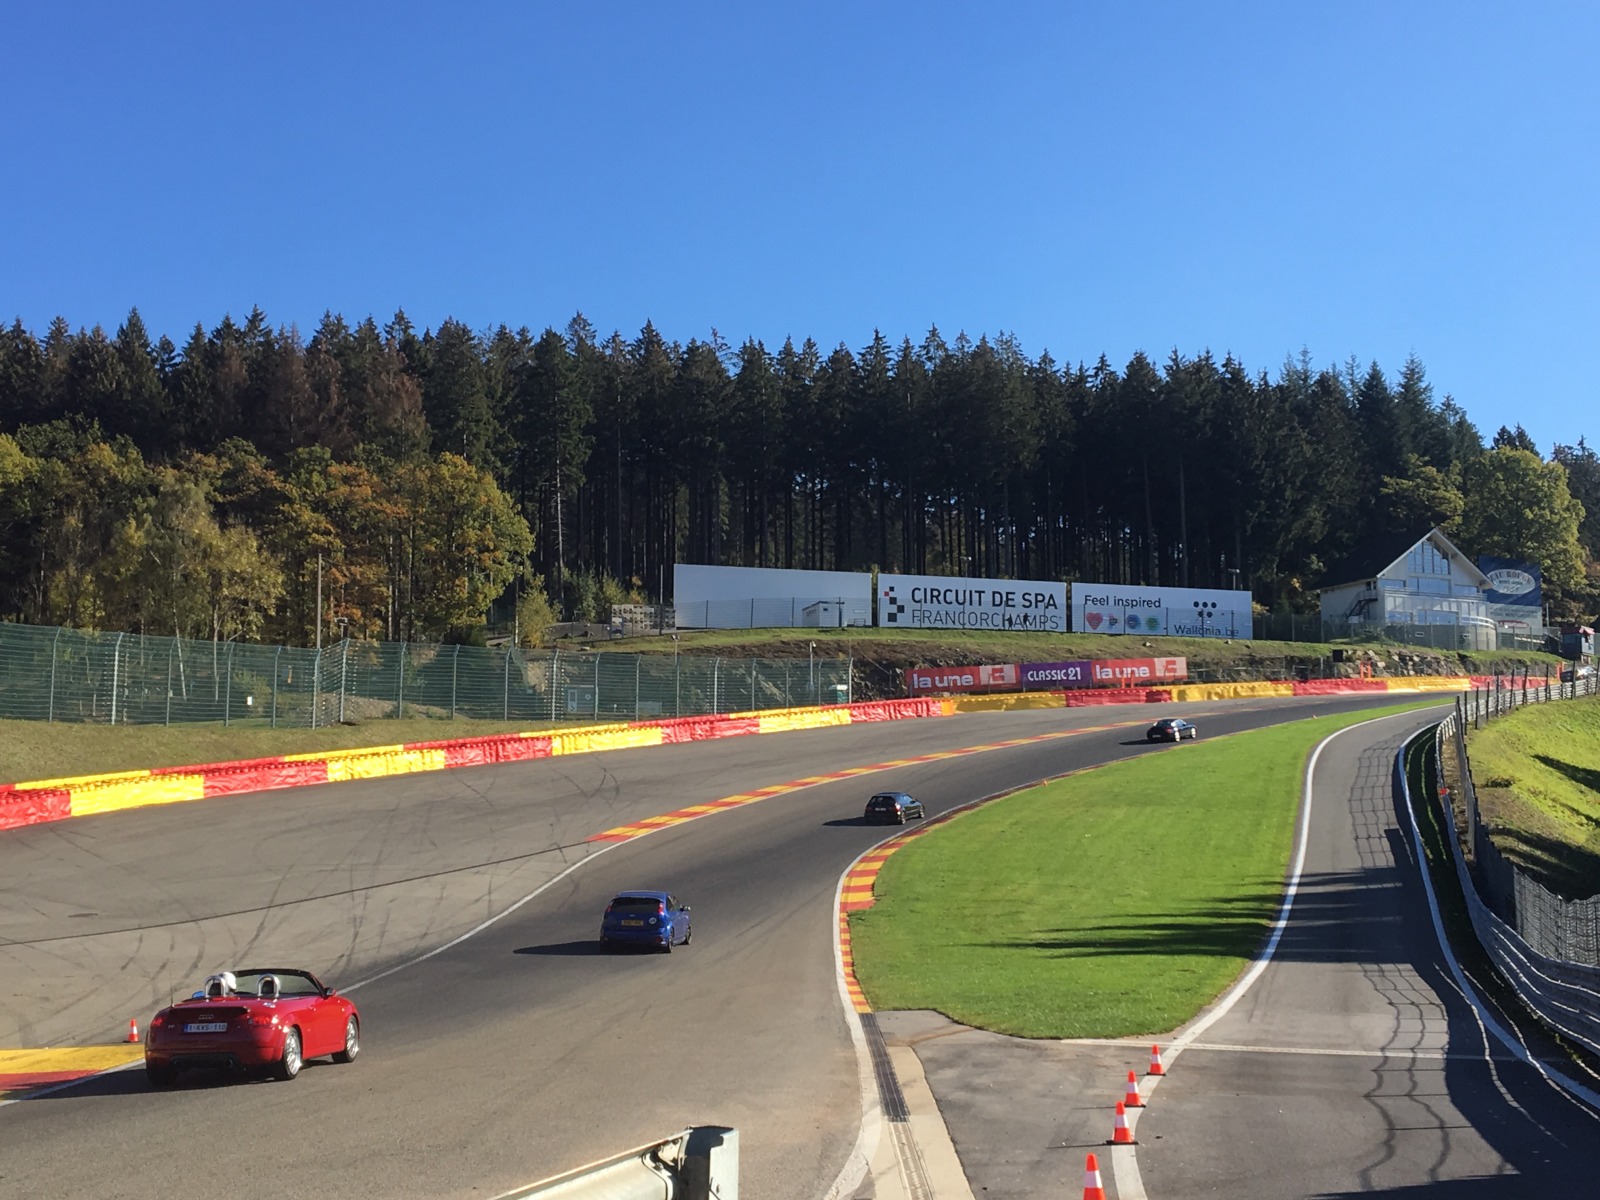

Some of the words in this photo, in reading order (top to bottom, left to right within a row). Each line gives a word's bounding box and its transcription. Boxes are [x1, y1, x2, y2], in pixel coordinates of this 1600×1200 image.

[911, 587, 986, 607] CIRCUIT
[991, 590, 1016, 608] DE
[1021, 592, 1058, 610] SPA
[1084, 594, 1110, 606] Feel
[1113, 595, 1161, 609] inspired
[911, 609, 1059, 630] FRANCORCHAMPS
[1173, 624, 1239, 637] Wallonia.be
[1095, 664, 1113, 679] la
[1115, 666, 1150, 678] une
[912, 673, 932, 689] la
[934, 674, 974, 688] une
